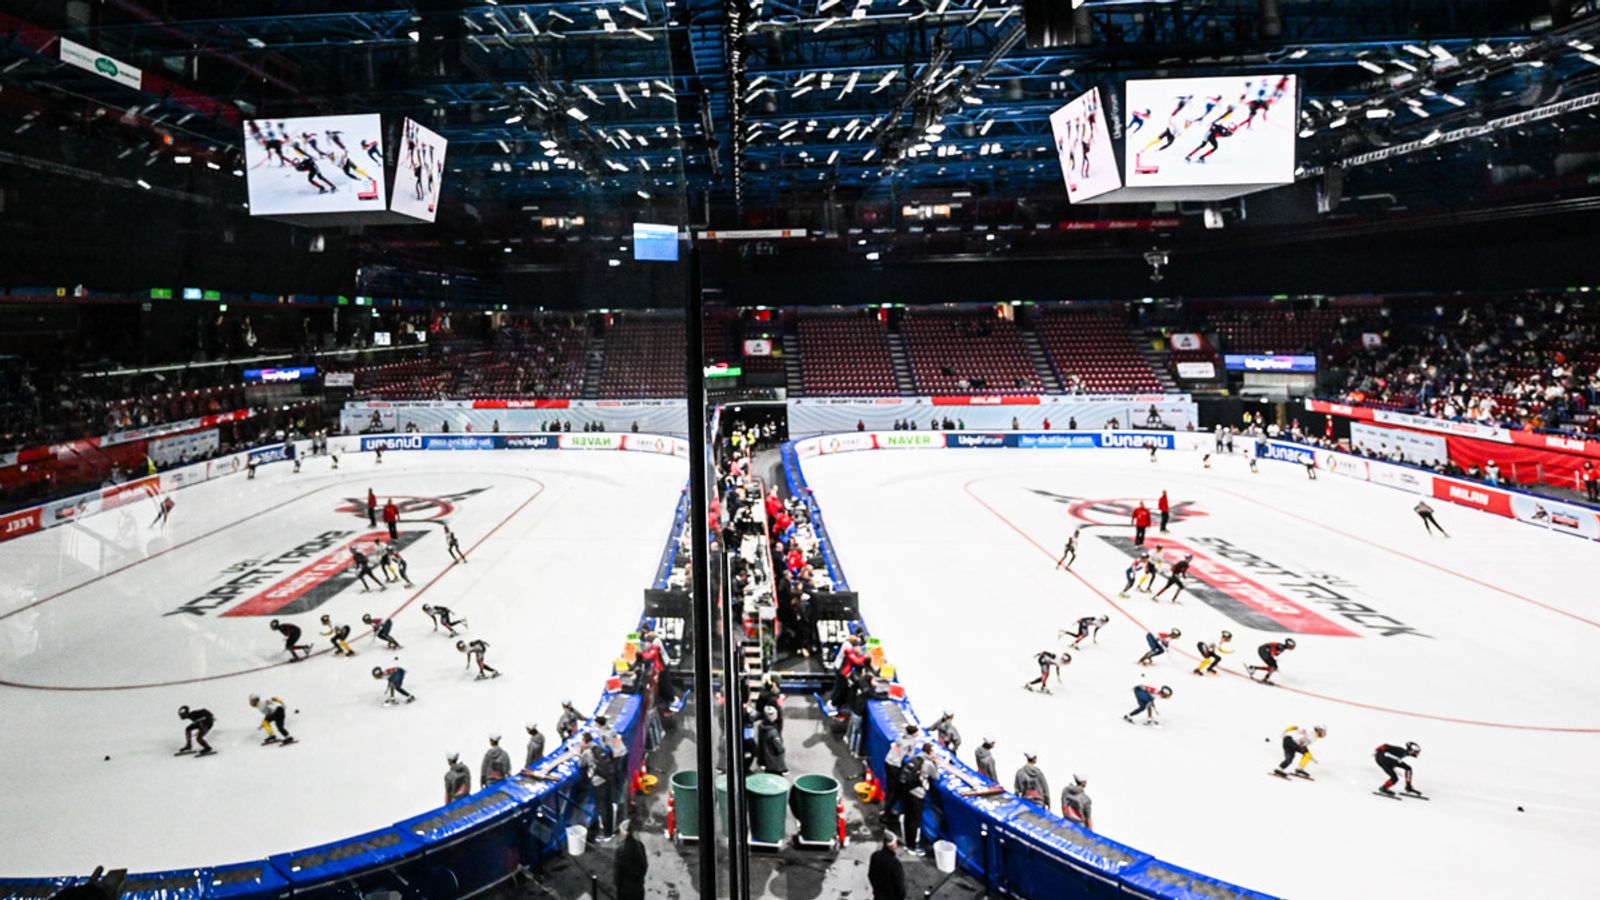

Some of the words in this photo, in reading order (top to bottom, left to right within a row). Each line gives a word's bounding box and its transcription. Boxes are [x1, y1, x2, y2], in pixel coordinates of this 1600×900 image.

[888, 436, 931, 445] NAVER
[1101, 432, 1168, 448] Dunamu
[1449, 486, 1489, 506] MILAN
